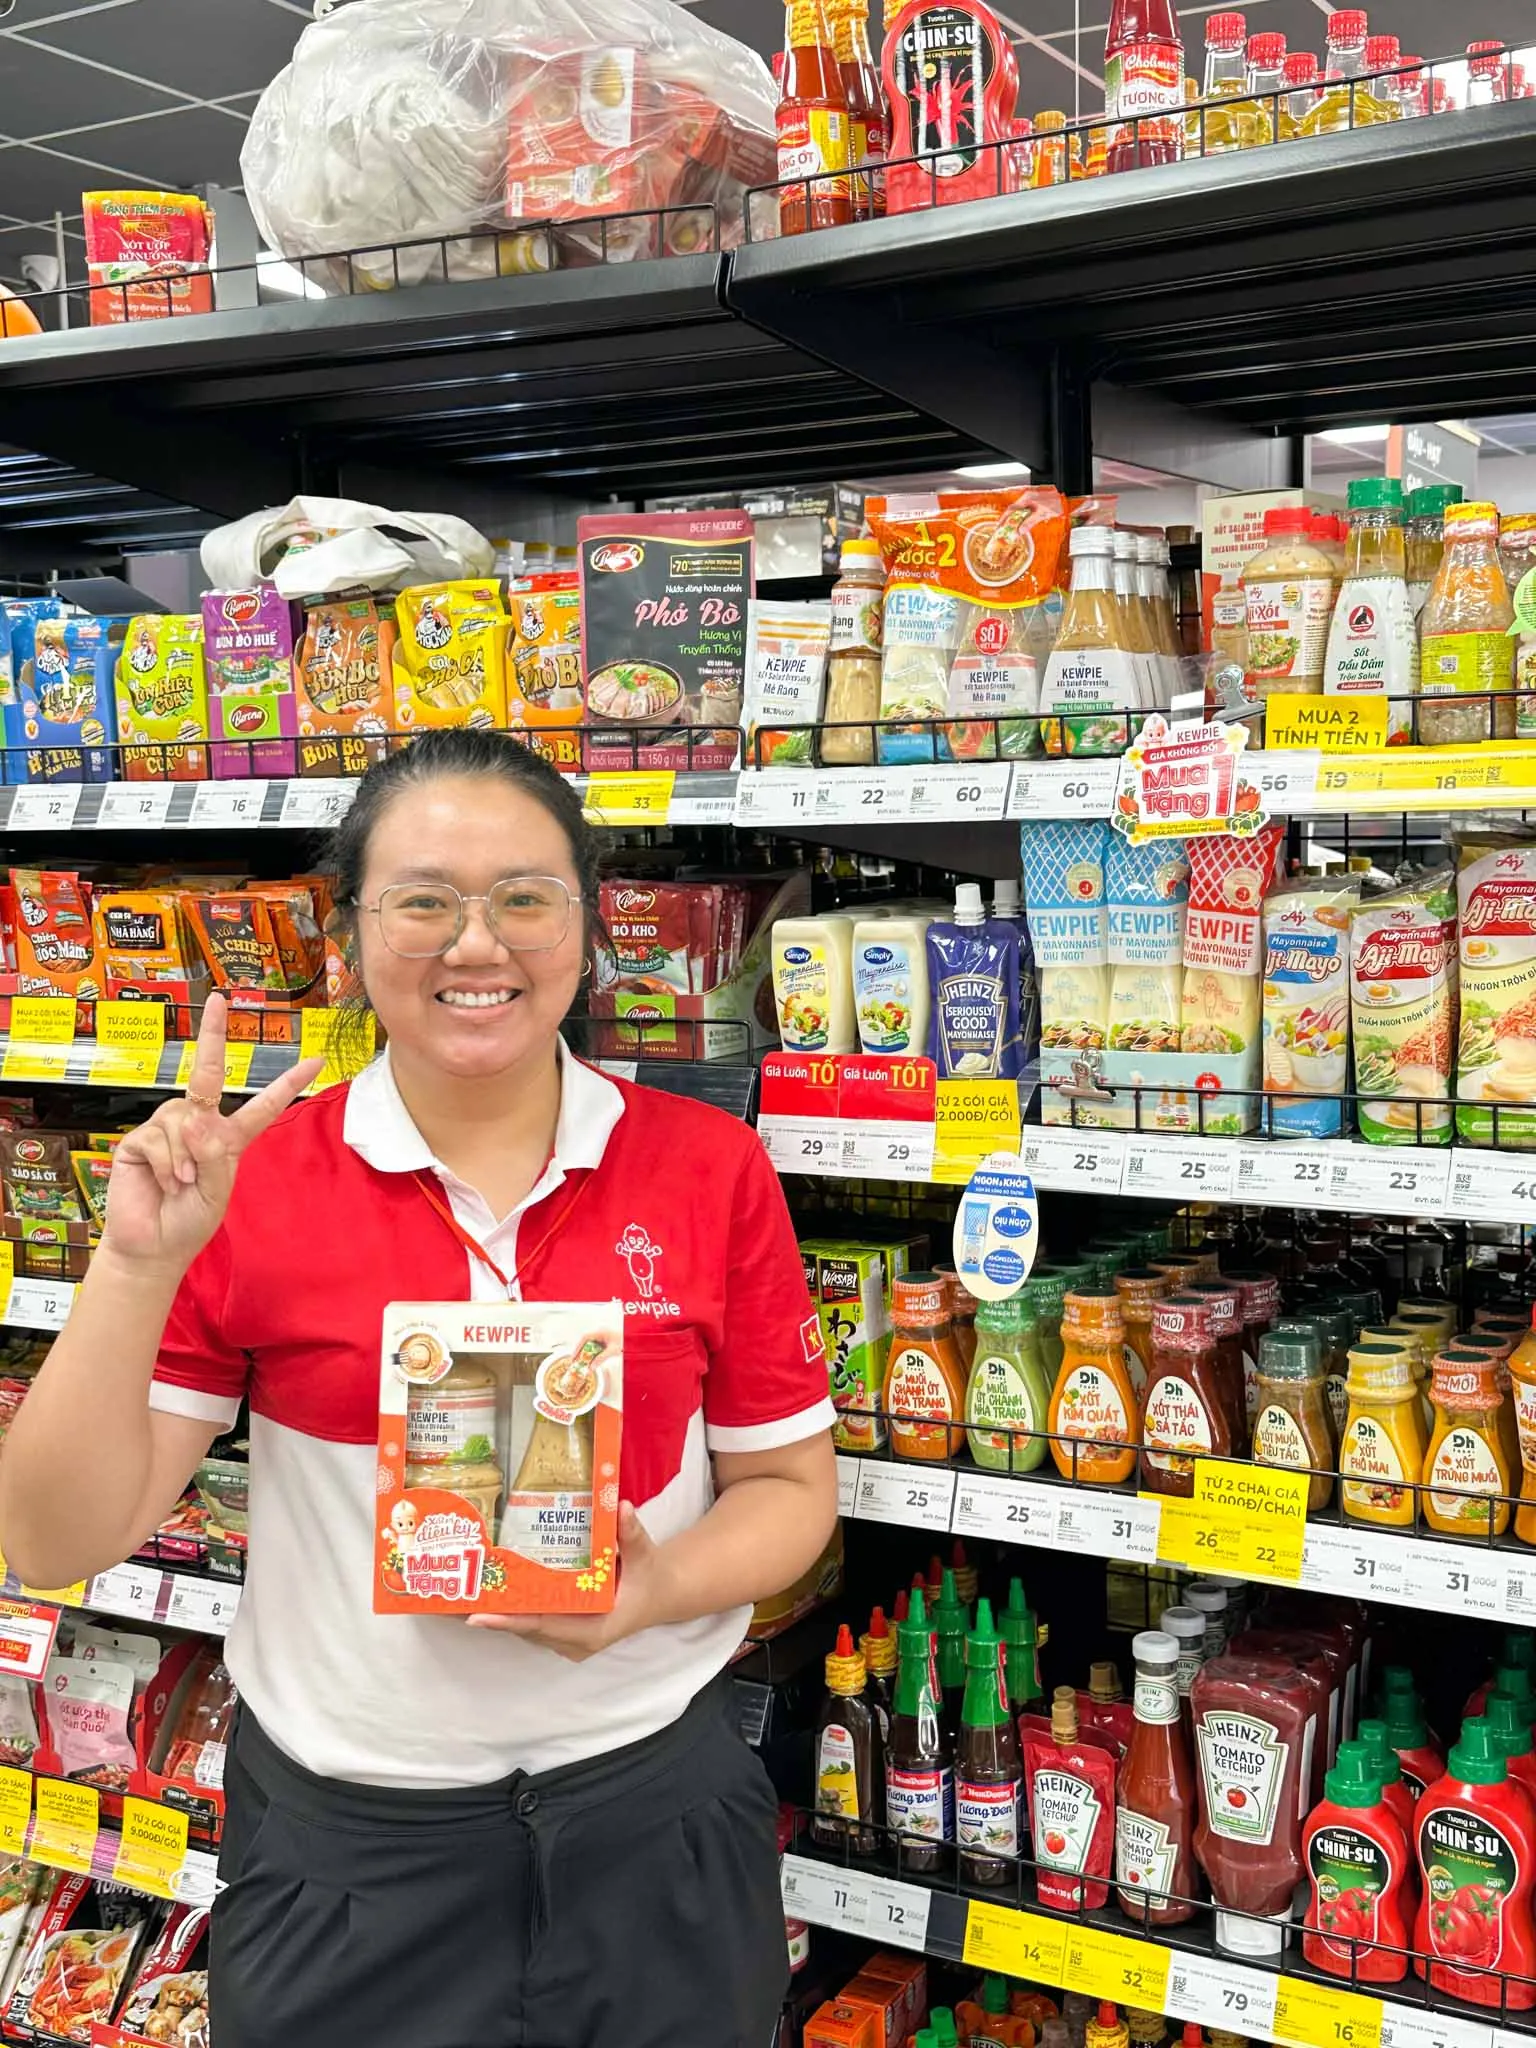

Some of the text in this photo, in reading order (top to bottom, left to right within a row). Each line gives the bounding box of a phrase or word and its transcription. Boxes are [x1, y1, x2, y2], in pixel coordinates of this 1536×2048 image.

[903, 25, 981, 53] CHIN-SU
[1122, 92, 1167, 107] TƯƠNG
[690, 522, 710, 533] BEEF
[916, 523, 936, 547] 1
[634, 597, 742, 627] Phở Bò
[700, 630, 730, 642] Hương
[678, 643, 742, 657] Truyền Thống
[1353, 647, 1369, 657] Sốt
[765, 657, 806, 673] KEWPIE
[1337, 657, 1384, 671] Dầu Dấm
[968, 671, 1009, 683] KEWPIE
[1062, 667, 1102, 679] KEWPIE
[763, 683, 799, 698] Mè Rang
[1064, 688, 1099, 700] Mè Rang
[1298, 709, 1360, 725] MUA 2
[1176, 726, 1220, 742] KEWPIE
[1272, 726, 1381, 746] TÍNH TIỀN 1
[1150, 752, 1166, 761] GIÁ
[1167, 746, 1200, 758] KHÔNG
[1141, 754, 1234, 817] Mua 1
[1261, 775, 1288, 791] 56
[1324, 770, 1348, 788] 19
[1435, 774, 1456, 790] 18
[861, 790, 884, 804] 22
[955, 787, 981, 802] 60
[1062, 782, 1089, 799] 60
[139, 800, 153, 813] 12
[232, 800, 246, 812] 16
[632, 797, 651, 810] 33
[791, 792, 805, 808] 11
[1141, 789, 1210, 818] Tặng
[48, 802, 61, 814] 12
[612, 922, 657, 936] BÒ KHO
[1109, 911, 1179, 934] KEWPIE
[1380, 928, 1441, 942] Mayonnaise
[1191, 942, 1253, 958] MAYONNAISE
[1271, 937, 1327, 949] Mayonnaise
[785, 948, 811, 961] Simply
[865, 948, 892, 961] Simply
[1474, 973, 1527, 991] NGON TRỘN
[949, 984, 992, 999] HEINZ
[953, 1017, 988, 1030] GOOD
[947, 1030, 996, 1040] MAYONNAISE
[844, 1058, 930, 1090] Giá Luôn TỐT
[953, 1097, 960, 1107] 2
[963, 1095, 985, 1107] GÓI
[988, 1094, 1009, 1107] GIÁ
[801, 1139, 823, 1156] 29
[887, 1144, 909, 1160] 29
[1073, 1153, 1097, 1171] 25
[1181, 1161, 1206, 1179] 25
[1294, 1163, 1320, 1180] 23
[973, 1175, 999, 1187] NGON
[1389, 1171, 1416, 1190] 23
[994, 1218, 1031, 1229] DỊU NGỌT
[823, 1273, 857, 1287] WASABI
[44, 1300, 56, 1313] 12
[1160, 1315, 1183, 1330] MỚI
[463, 1326, 531, 1343] KEWPIE
[907, 1355, 924, 1368] Dh
[988, 1363, 1006, 1376] Dh
[905, 1371, 927, 1385] MUỐI
[1079, 1372, 1099, 1384] Dh
[1449, 1374, 1475, 1392] MỚI
[895, 1382, 940, 1396] CHANH ỚT
[987, 1380, 1008, 1393] MUỐI
[1164, 1382, 1184, 1396] Dh
[893, 1396, 945, 1409] NHA TRANG
[988, 1394, 1022, 1406] CHANH
[1080, 1391, 1101, 1407] XỐT
[974, 1405, 1026, 1419] NHA TRANG
[1063, 1407, 1084, 1420] KIM
[1152, 1398, 1199, 1418] XỐT THÁI
[410, 1412, 449, 1423] KEWPIE
[1268, 1411, 1286, 1426] Dh
[1260, 1428, 1298, 1446] XỐT MUỐI
[1357, 1422, 1376, 1437] Dh
[410, 1431, 448, 1444] Mè Rang
[1452, 1434, 1475, 1449] Dh
[1359, 1443, 1377, 1458] XỐT
[1368, 1461, 1389, 1475] MAI
[1455, 1454, 1476, 1470] XỐT
[1471, 1468, 1498, 1484] MUỐI
[1204, 1476, 1300, 1500] TỪ 2 CHAI GIÁ
[906, 1490, 928, 1508] 25
[538, 1511, 585, 1523] KEWPIE
[1006, 1505, 1030, 1523] 25
[1111, 1519, 1133, 1539] 31
[541, 1534, 582, 1547] Mè Rang
[1194, 1530, 1219, 1547] 26
[1255, 1546, 1276, 1562] 22
[407, 1549, 480, 1597] Mua 1
[1353, 1556, 1377, 1577] 31
[407, 1572, 461, 1597] Tặng
[1446, 1571, 1470, 1593] 31
[130, 1585, 143, 1599] 12
[211, 1602, 221, 1615] 8
[1216, 1722, 1263, 1745] HEINZ
[1212, 1744, 1266, 1766] TOMATO
[1214, 1757, 1263, 1777] KETCHUP
[1040, 1777, 1083, 1798] HEINZ
[1040, 1798, 1079, 1815] TOMATO
[1042, 1810, 1076, 1822] KETCHUP
[1447, 1814, 1478, 1828] Tương cà
[4, 1825, 14, 1837] 12
[834, 1889, 848, 1908] 11
[887, 1904, 905, 1923] 12
[1023, 1943, 1041, 1962] 14
[1122, 1968, 1144, 1989] 32
[1222, 1990, 1248, 2011] 79
[1335, 2022, 1354, 2041] 16
